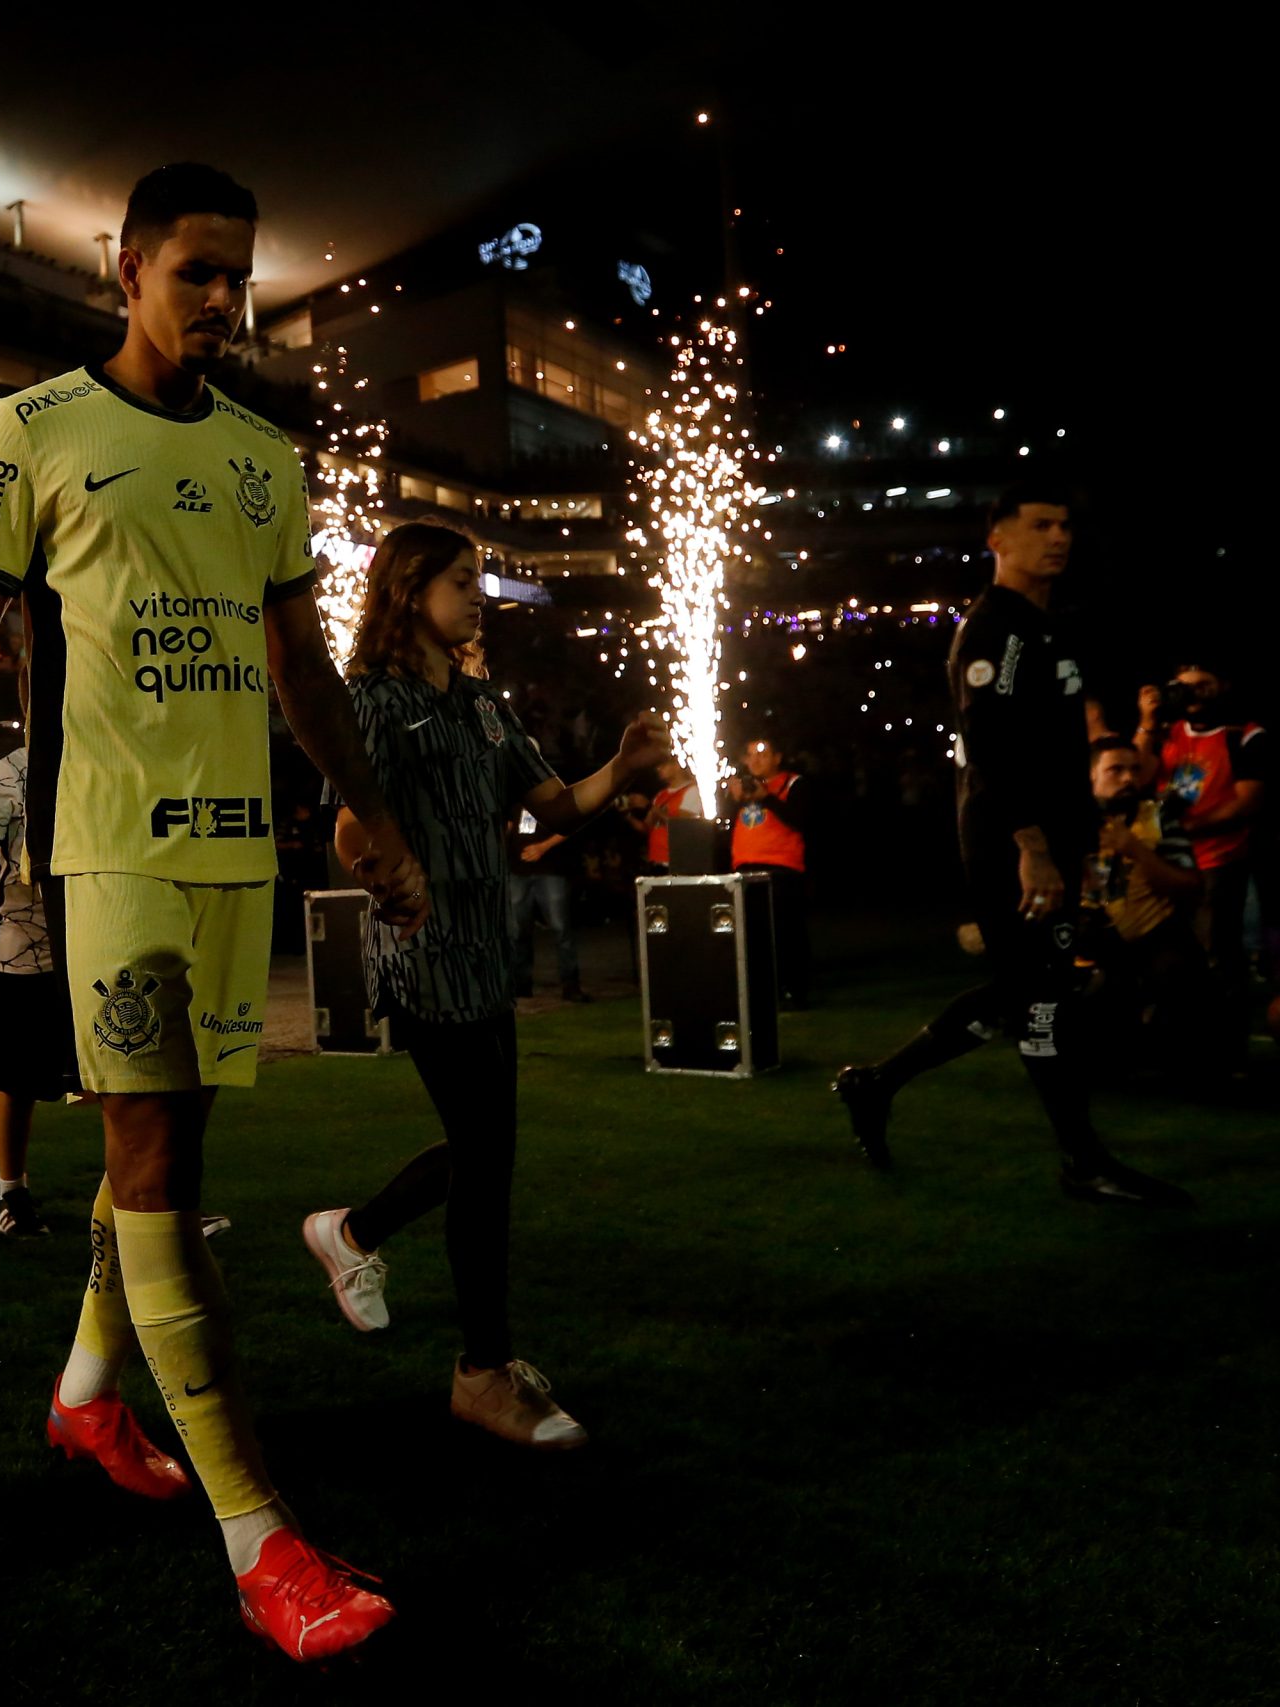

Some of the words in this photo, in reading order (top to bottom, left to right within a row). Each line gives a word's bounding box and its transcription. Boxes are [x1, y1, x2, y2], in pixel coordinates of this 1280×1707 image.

[15, 381, 103, 425] pixbet
[173, 501, 214, 513] ALE
[132, 626, 212, 656] neo
